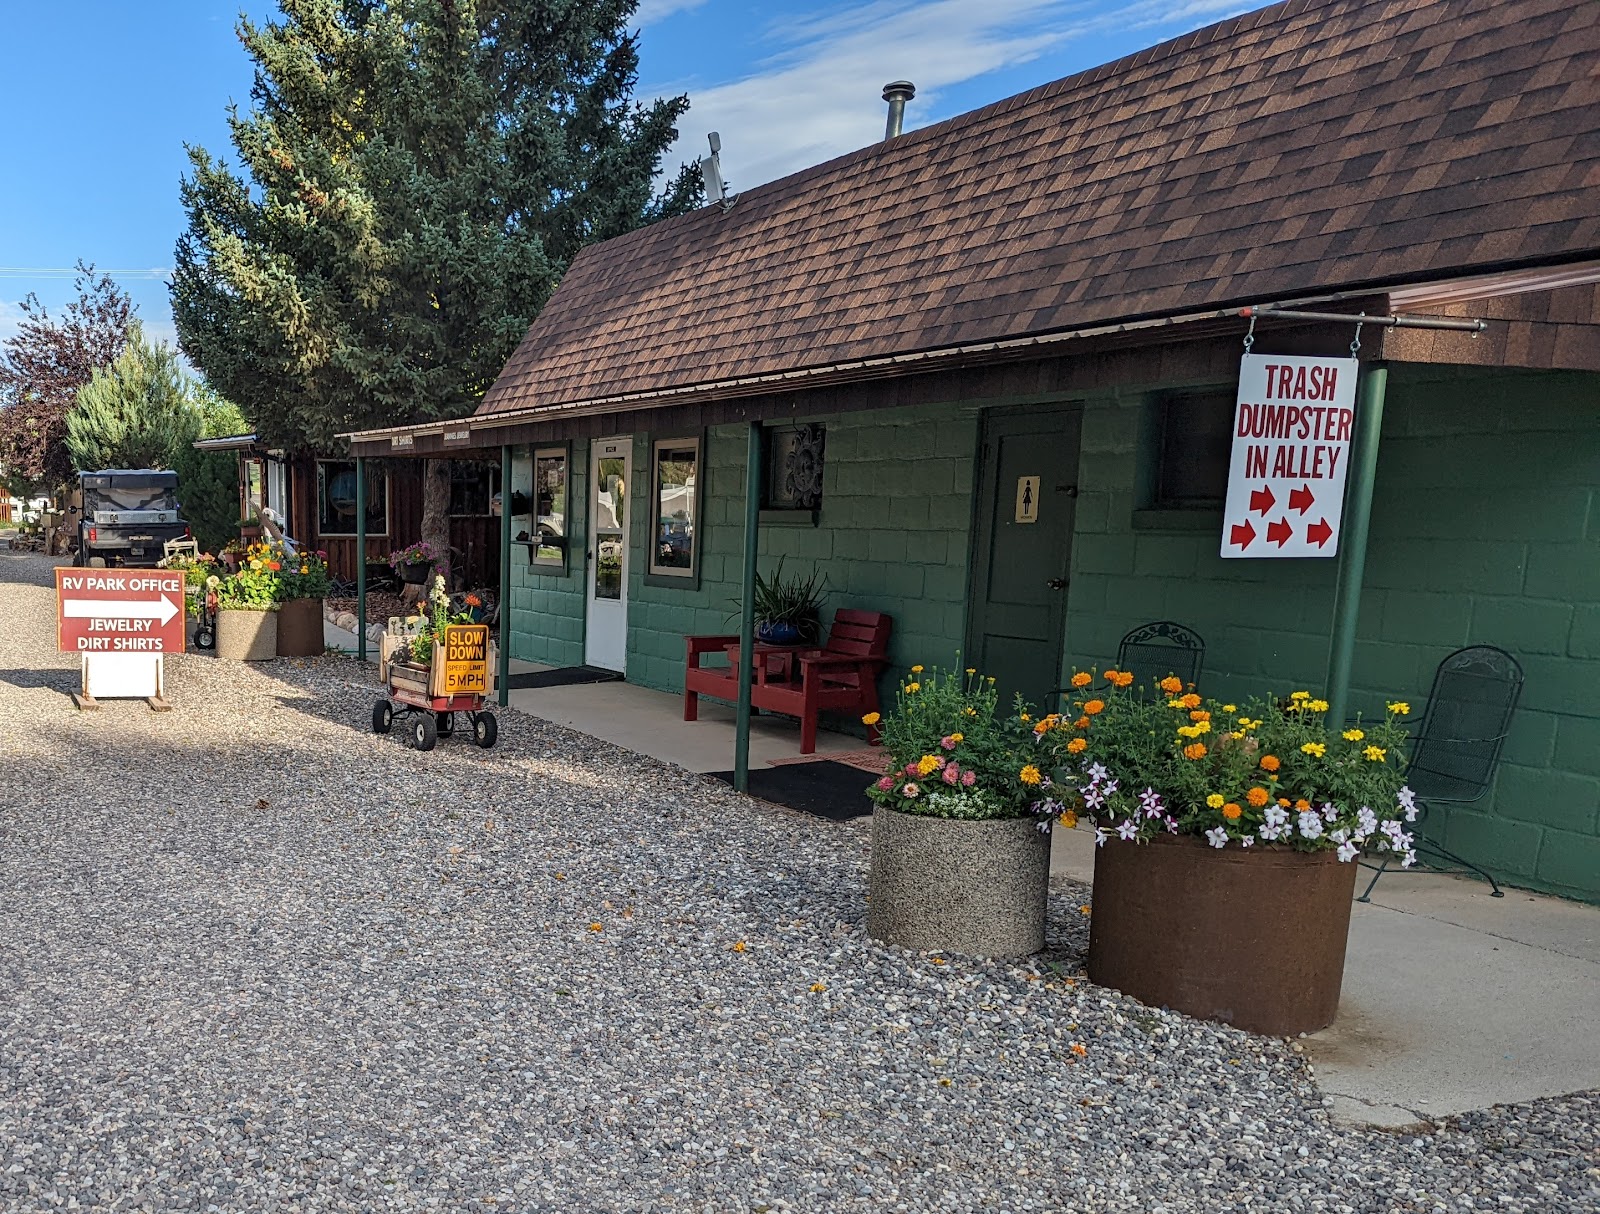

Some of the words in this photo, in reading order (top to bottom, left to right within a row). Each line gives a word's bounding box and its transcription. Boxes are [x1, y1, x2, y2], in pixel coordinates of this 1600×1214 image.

[1265, 365, 1338, 401] TRASH
[1237, 403, 1353, 442] DUMPSTER
[399, 434, 413, 446] SHIRTS
[1245, 445, 1269, 479] IN
[1272, 445, 1341, 480] ALLEY
[62, 577, 84, 590] RV
[87, 577, 126, 591] PARK
[129, 578, 180, 592] OFFICE
[88, 618, 153, 632] JEWELRY
[77, 637, 111, 650] DIRT
[113, 637, 163, 650] SHIRTS
[449, 631, 484, 646] SLOW
[449, 646, 483, 660] DOWN
